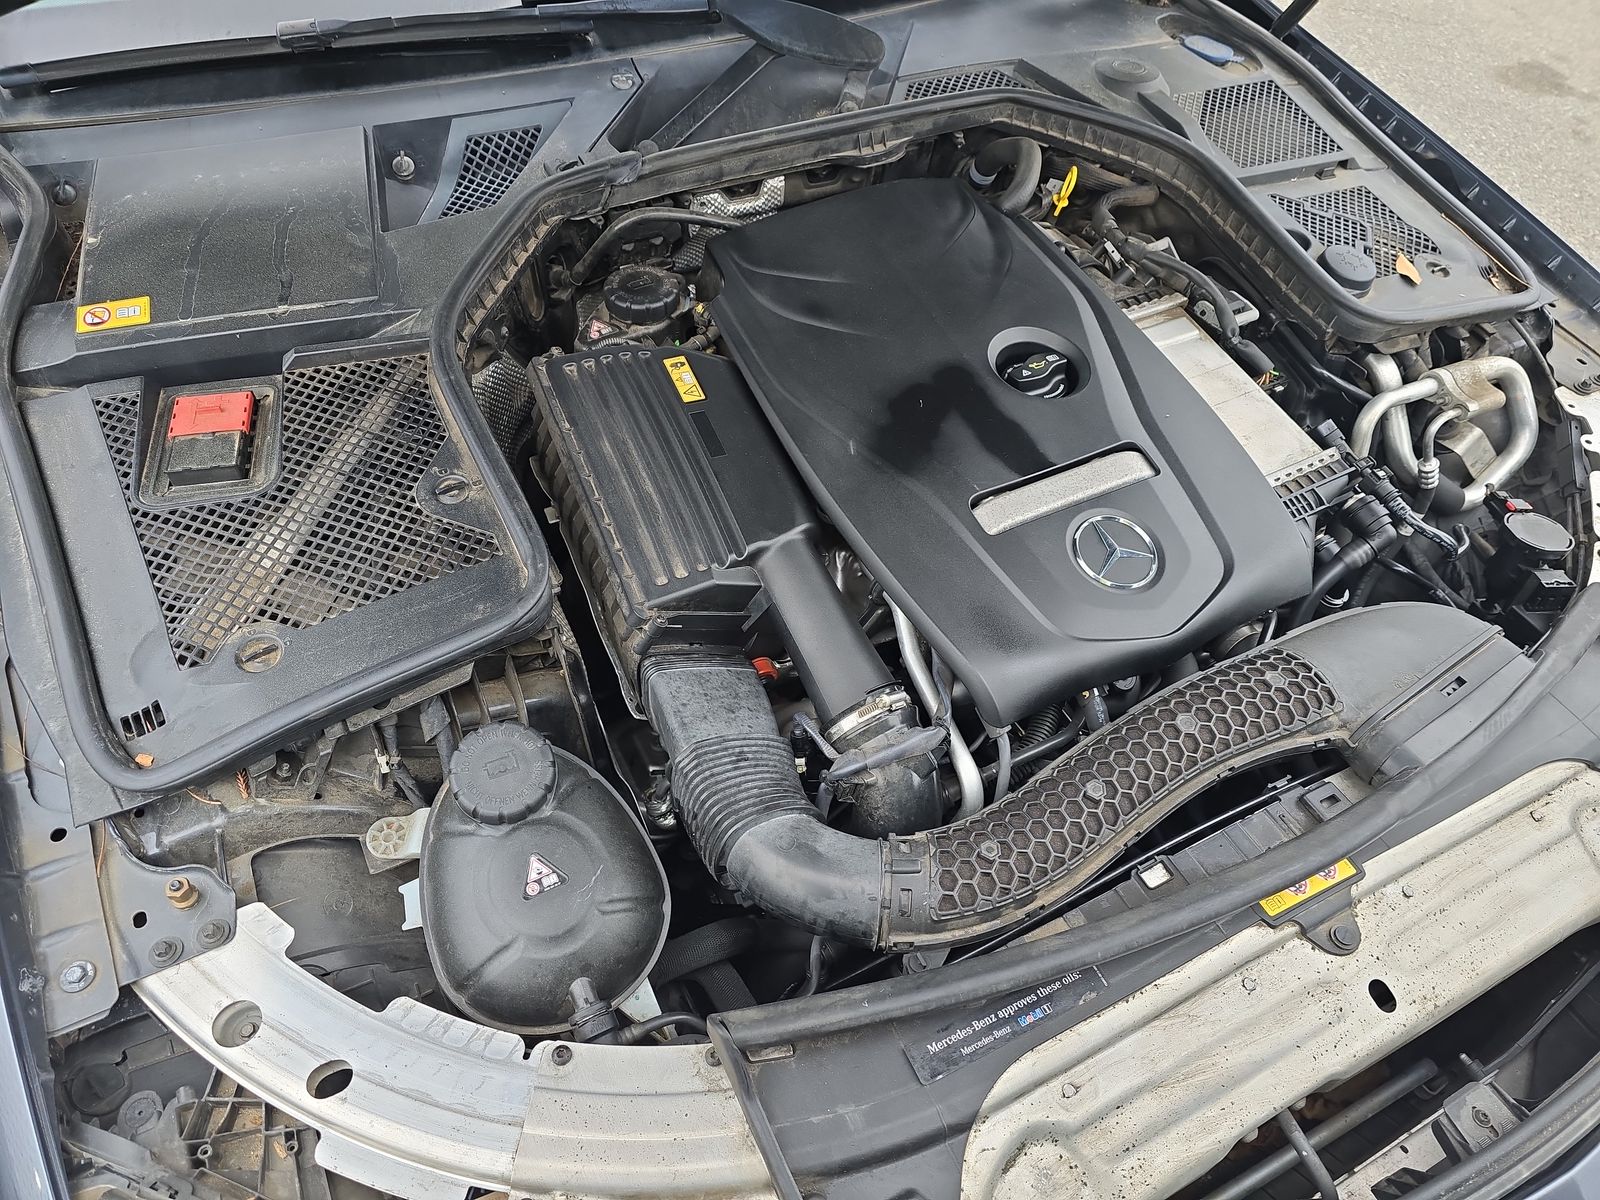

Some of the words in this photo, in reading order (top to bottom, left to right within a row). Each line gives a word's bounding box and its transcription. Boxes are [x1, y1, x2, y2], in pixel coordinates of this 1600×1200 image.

[477, 732, 499, 745] OPEN
[926, 1011, 998, 1055] Mercedes-Benz
[997, 993, 1037, 1019] approves
[1036, 980, 1062, 999] these
[1062, 970, 1082, 985] oils:
[959, 1024, 1012, 1056] Mercedes-Benz
